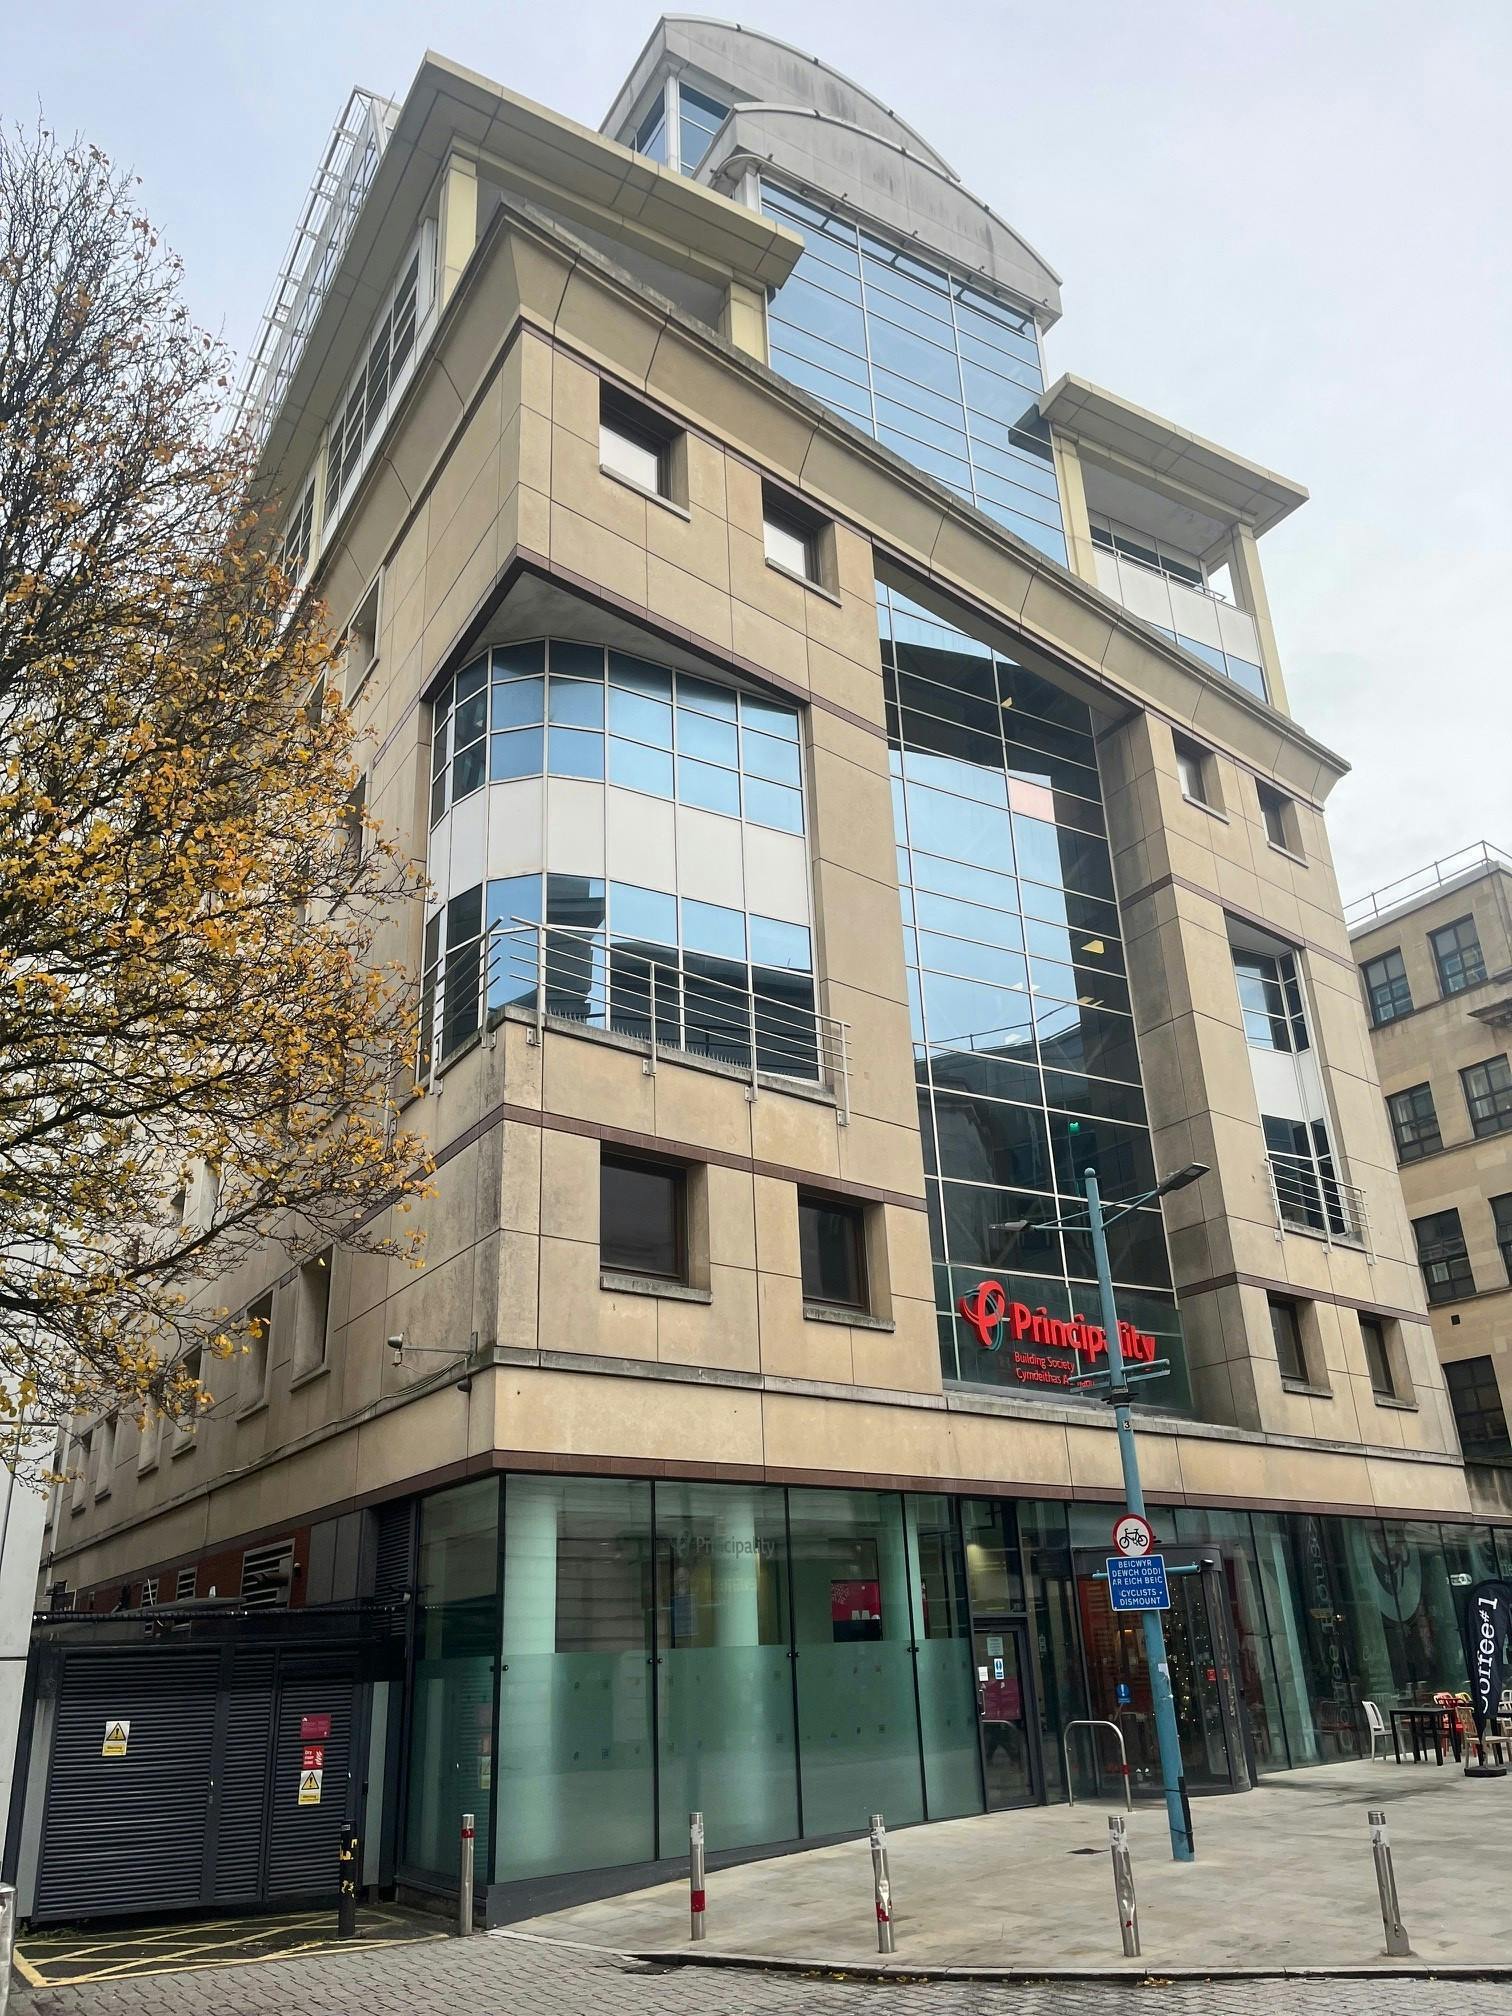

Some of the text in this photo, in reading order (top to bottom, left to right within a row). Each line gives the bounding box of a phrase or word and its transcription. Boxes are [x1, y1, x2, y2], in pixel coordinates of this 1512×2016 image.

[1010, 1302, 1156, 1370] Principlity
[1014, 1351, 1075, 1373] Building Society
[1015, 1367, 1062, 1385] Cymdeithas
[1124, 1420, 1130, 1429] 3
[696, 1535, 775, 1560] Pricipality
[1118, 1560, 1152, 1568] BEICWYR
[1112, 1567, 1161, 1577] DEWCH ODDI
[1112, 1576, 1163, 1586] AR EICH BEIC
[1121, 1588, 1157, 1597] CYCLISTS
[1119, 1597, 1161, 1606] DISMOUNT
